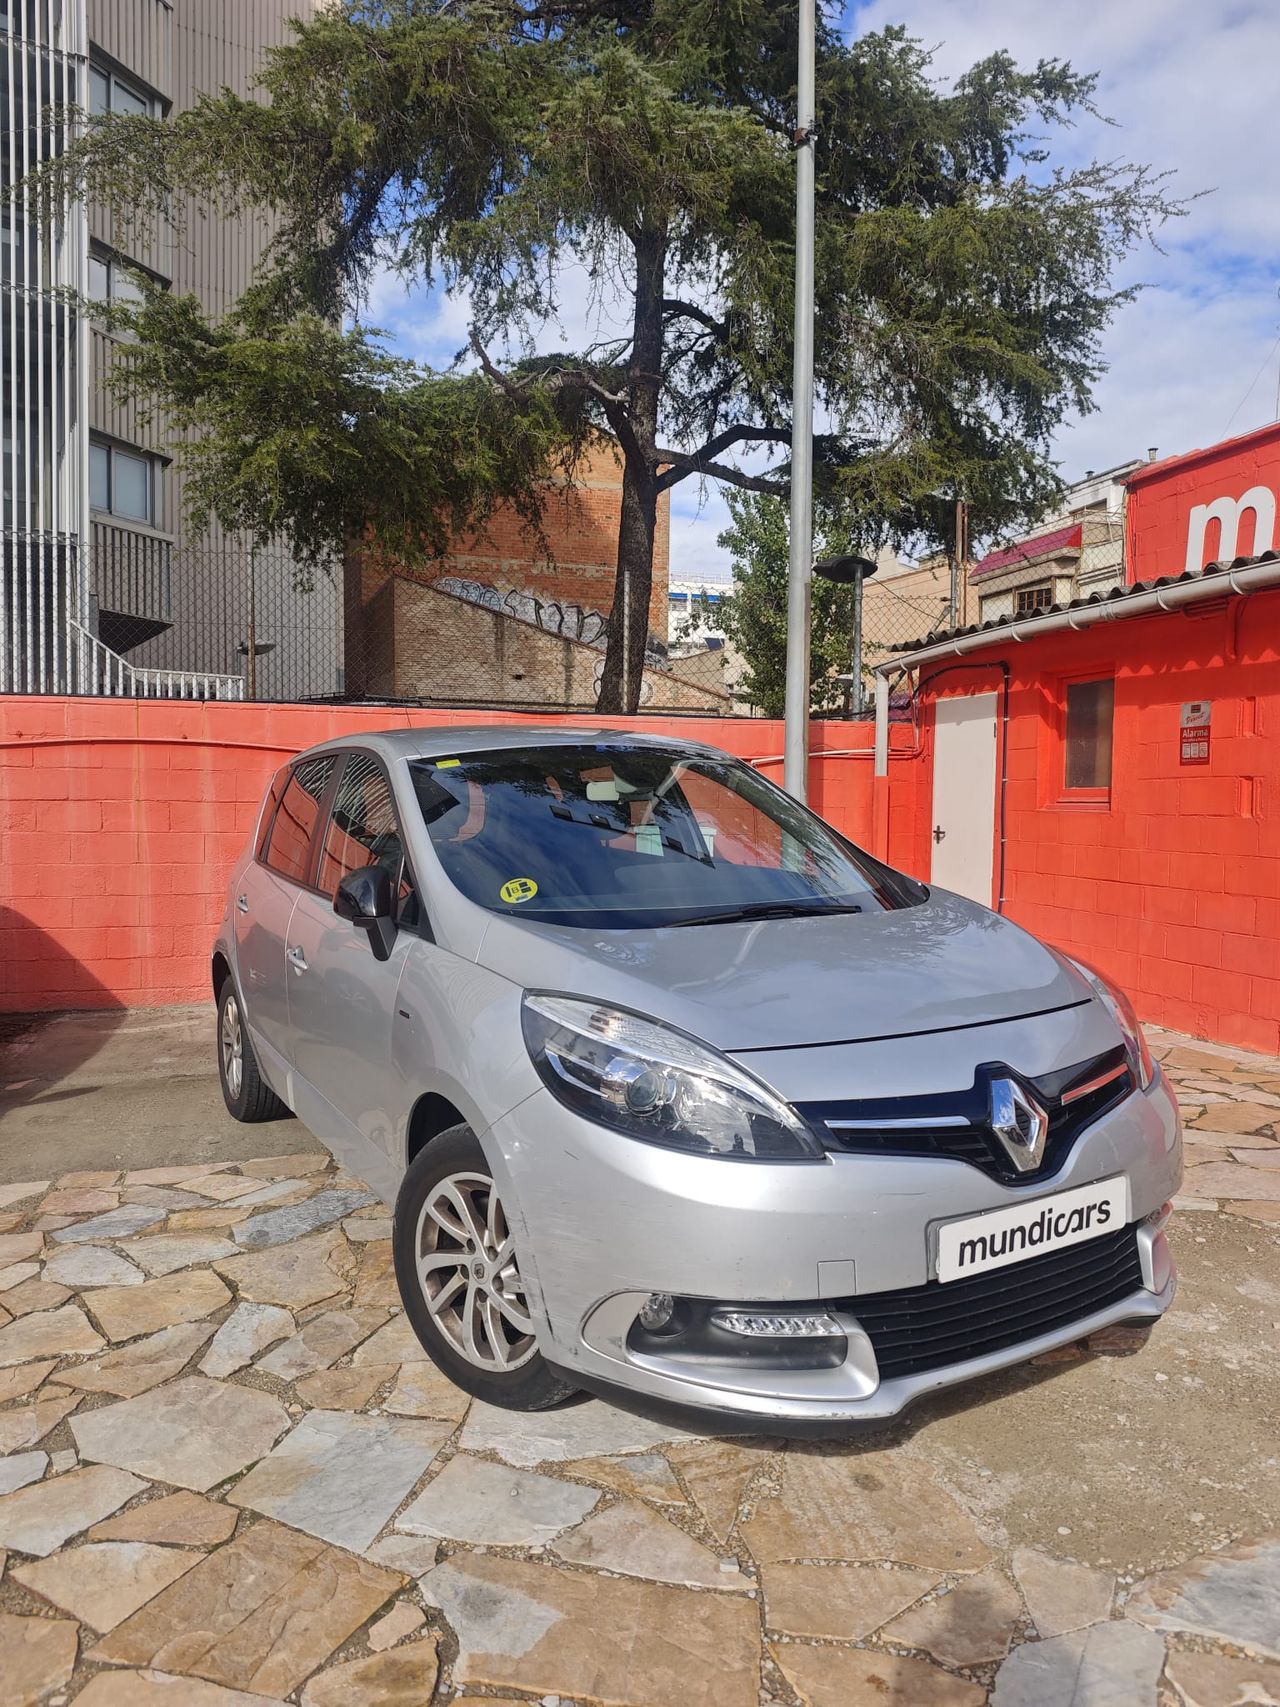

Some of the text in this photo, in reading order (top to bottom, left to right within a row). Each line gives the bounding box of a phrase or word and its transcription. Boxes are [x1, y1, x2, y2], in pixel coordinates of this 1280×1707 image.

[1185, 486, 1276, 572] m
[1182, 729, 1209, 738] Alarma
[958, 1199, 1111, 1267] mundicars
